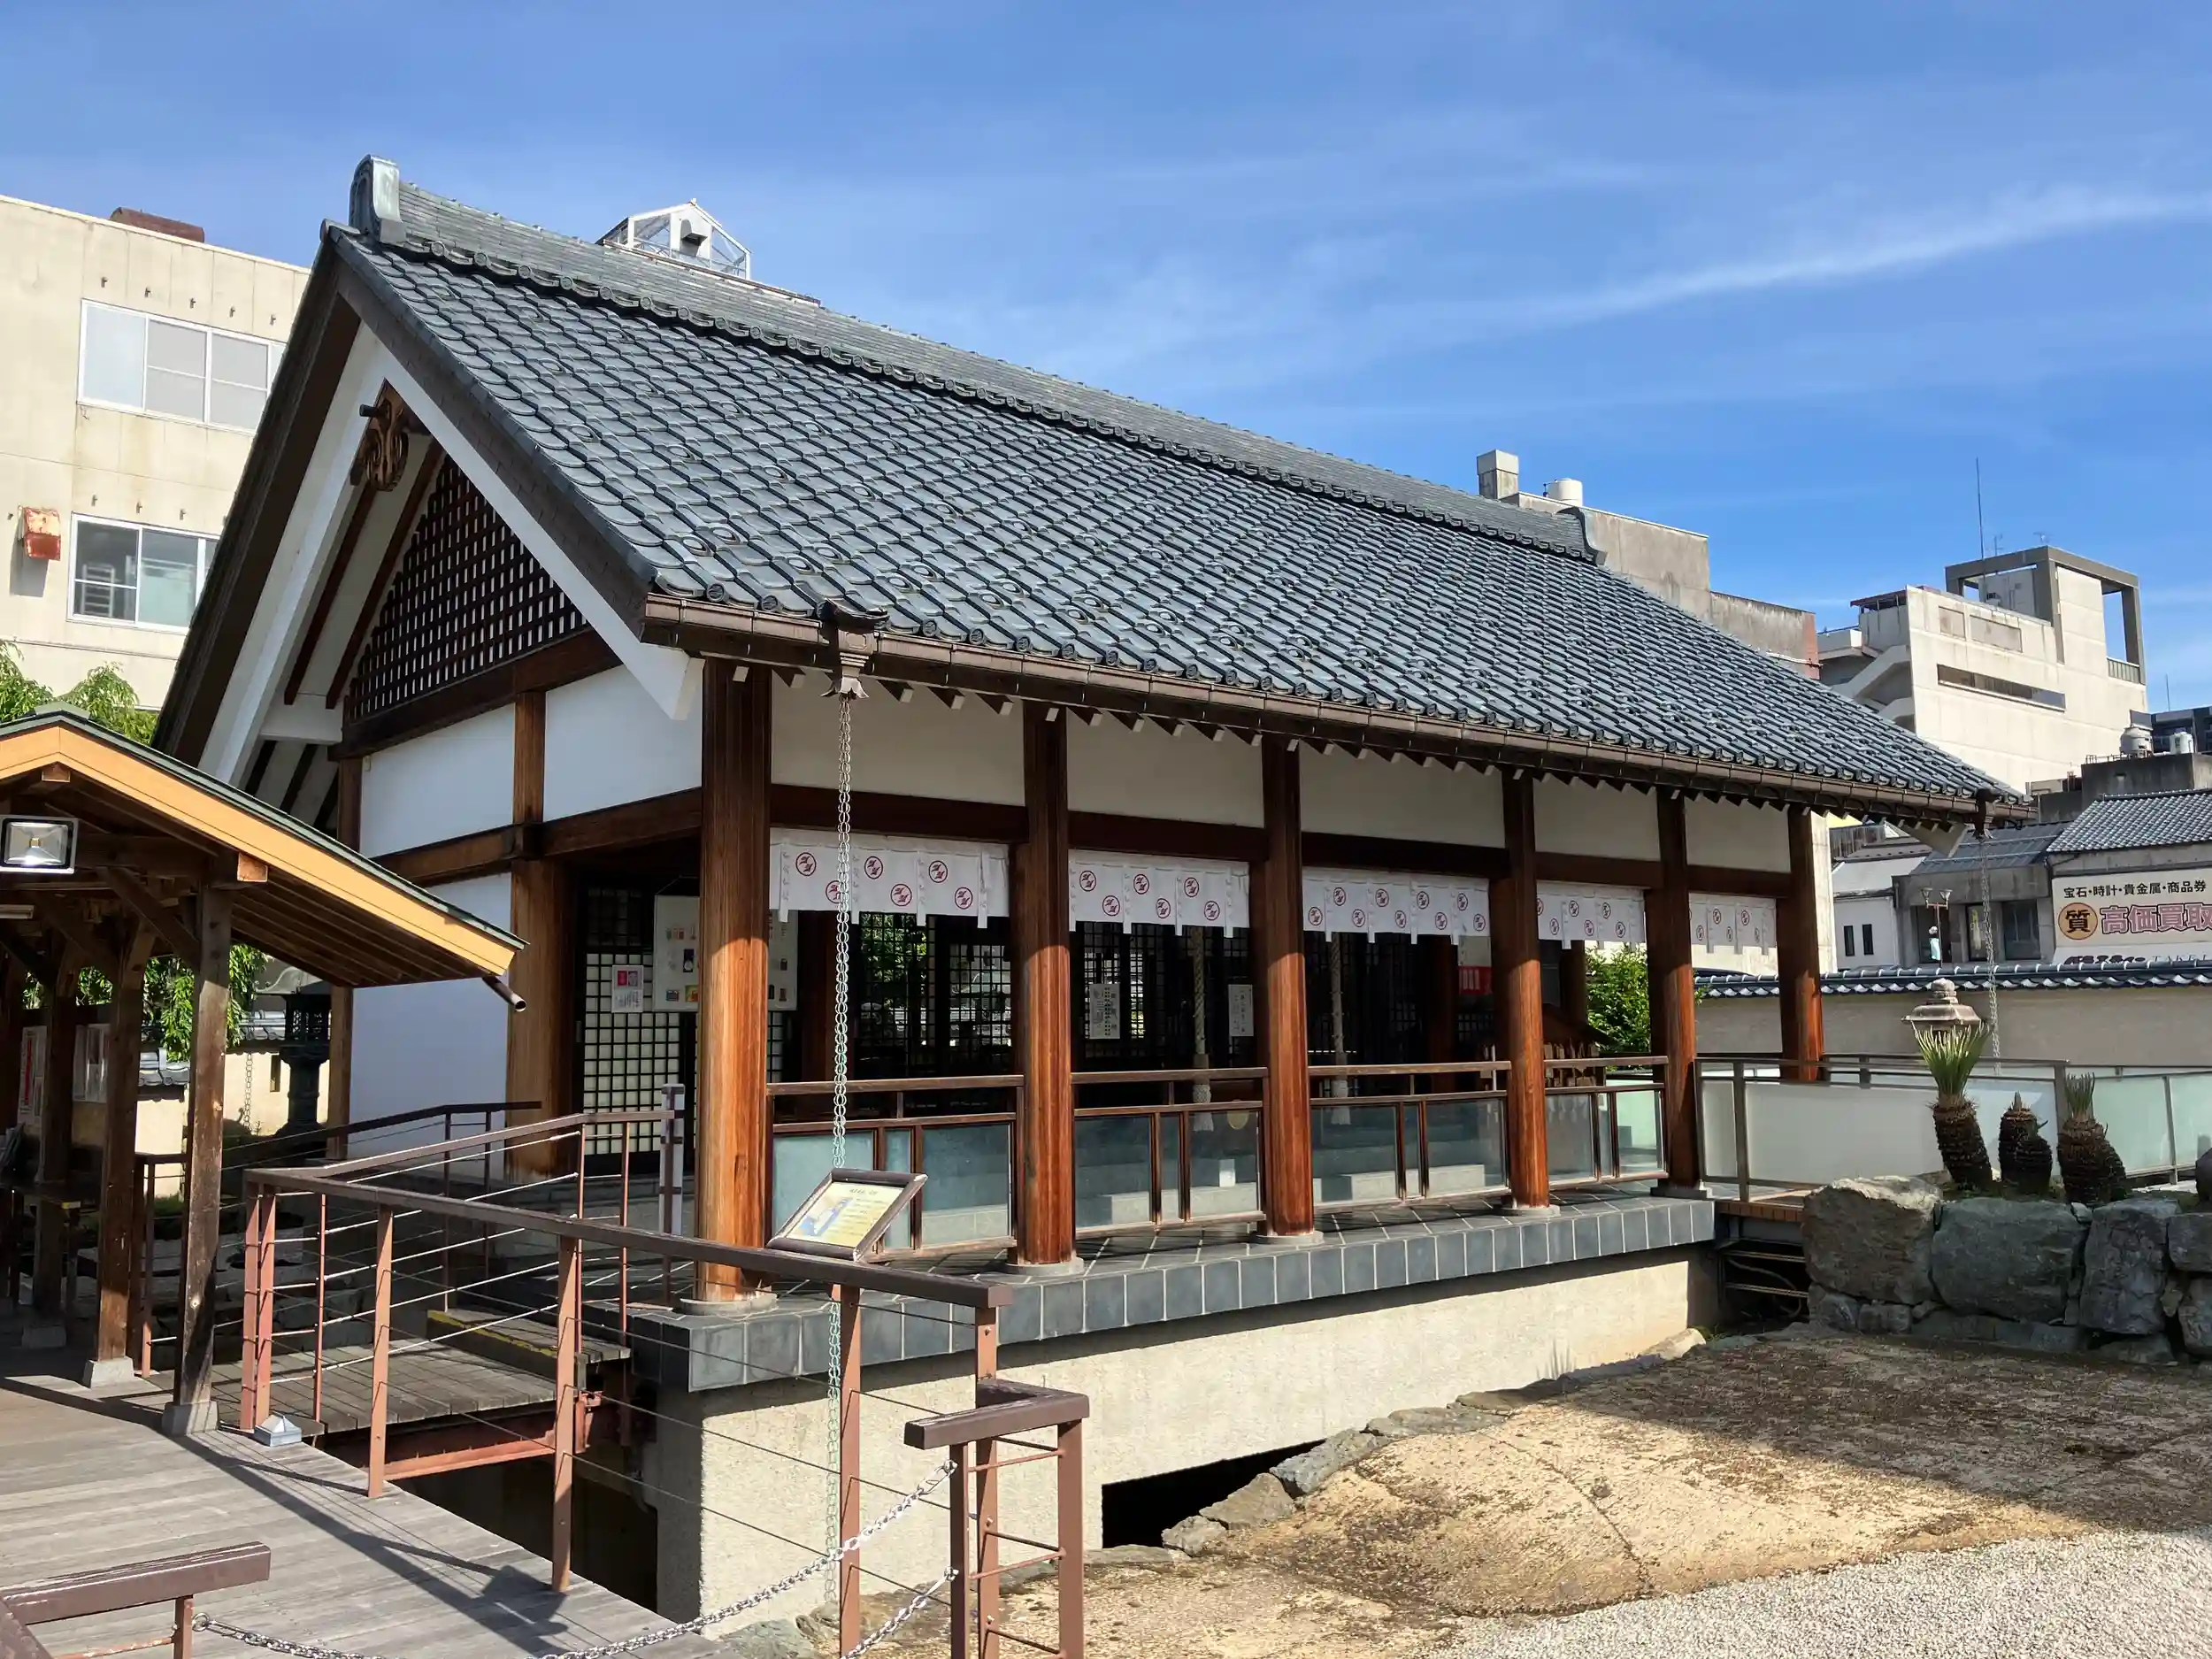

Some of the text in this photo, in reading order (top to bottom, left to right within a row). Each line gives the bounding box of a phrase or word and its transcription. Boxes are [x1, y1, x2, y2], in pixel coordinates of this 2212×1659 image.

[2065, 902, 2212, 934] 質 高価買取
